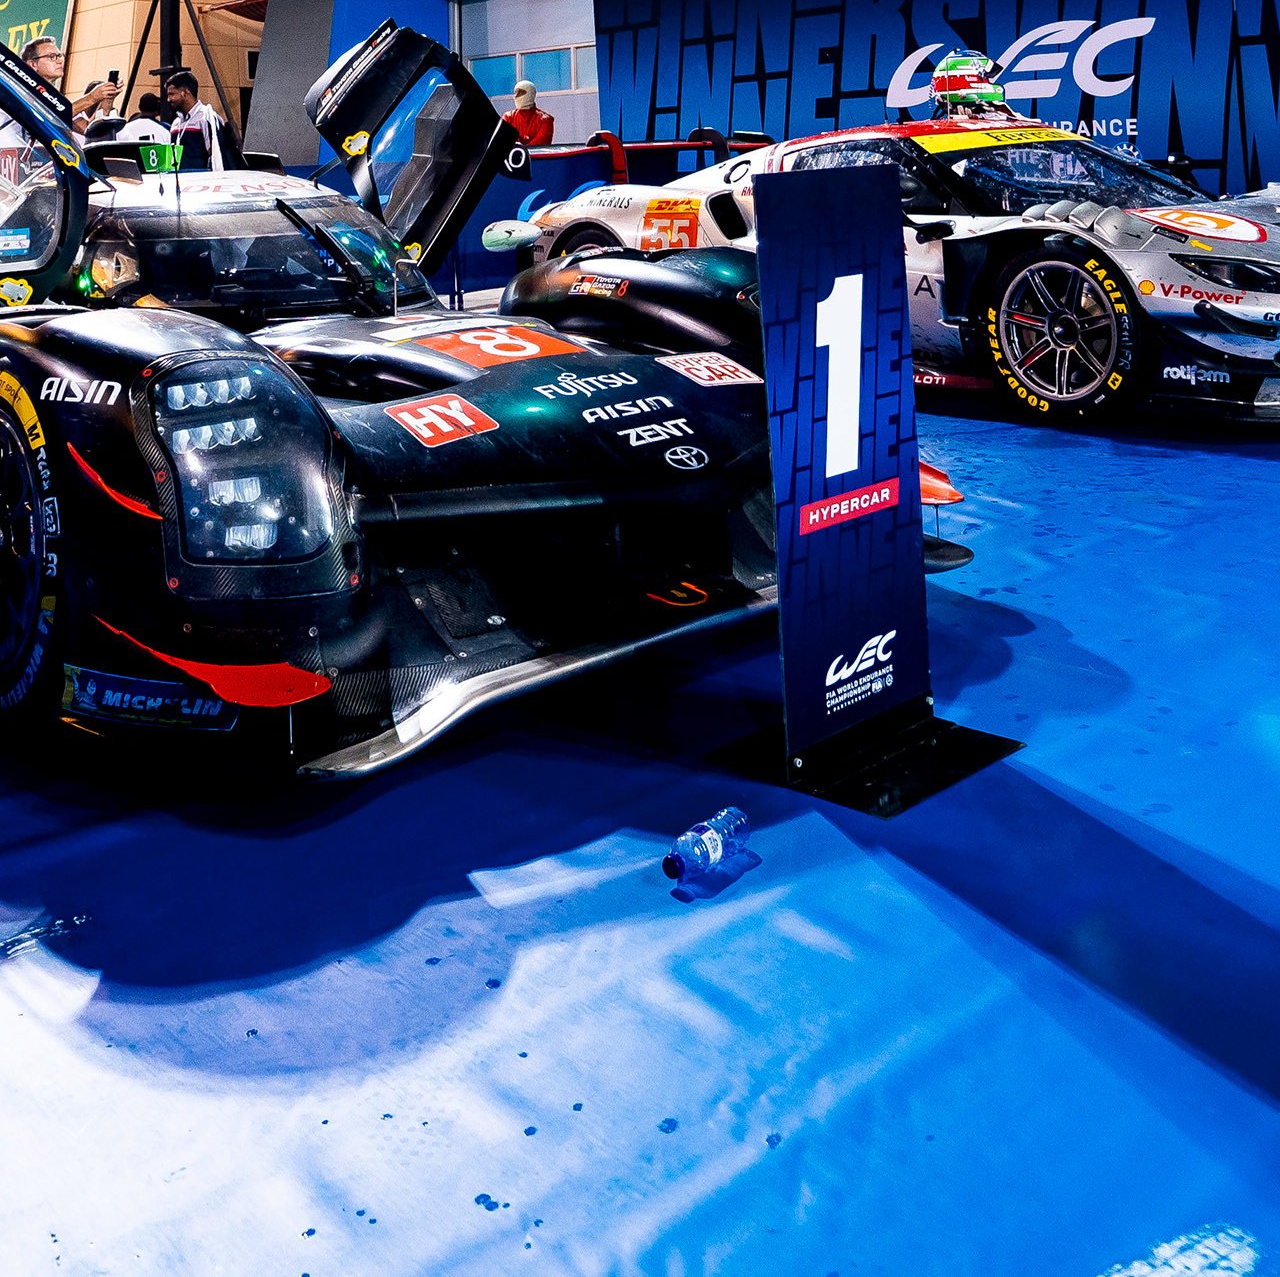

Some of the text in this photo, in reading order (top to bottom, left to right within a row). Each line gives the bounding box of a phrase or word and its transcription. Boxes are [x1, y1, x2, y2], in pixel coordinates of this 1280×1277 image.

[4, 59, 38, 88] GAZOO
[35, 85, 66, 112] Racing
[331, 67, 354, 94] TOYOTA
[1044, 118, 1139, 138] URANCE
[148, 149, 158, 167] 8
[182, 179, 307, 194] DENSO
[654, 200, 693, 211] DHL
[649, 219, 691, 249] 55
[589, 288, 613, 297] Racing
[596, 276, 622, 284] TOYOTA
[617, 279, 630, 297] 8
[1084, 258, 1128, 314] EAGLE
[1160, 283, 1244, 305] V-Power
[459, 331, 541, 357] 8
[667, 354, 728, 369] HYPER
[683, 363, 756, 384] CAR
[533, 372, 639, 400] FUJITSU
[815, 273, 864, 479] 1
[1163, 364, 1231, 386] rotiform
[40, 376, 122, 407] AISIN
[398, 399, 479, 438] HY
[582, 395, 675, 423] AISIN
[26, 420, 41, 443] M
[616, 418, 696, 448] ZENT
[808, 485, 892, 526] HYPERCAR
[825, 629, 897, 687] WEC
[825, 664, 894, 701] FIA WORLD ENDURANCE
[826, 682, 872, 708] CHAMPIONSHIP
[101, 688, 224, 717] MICHLIN
